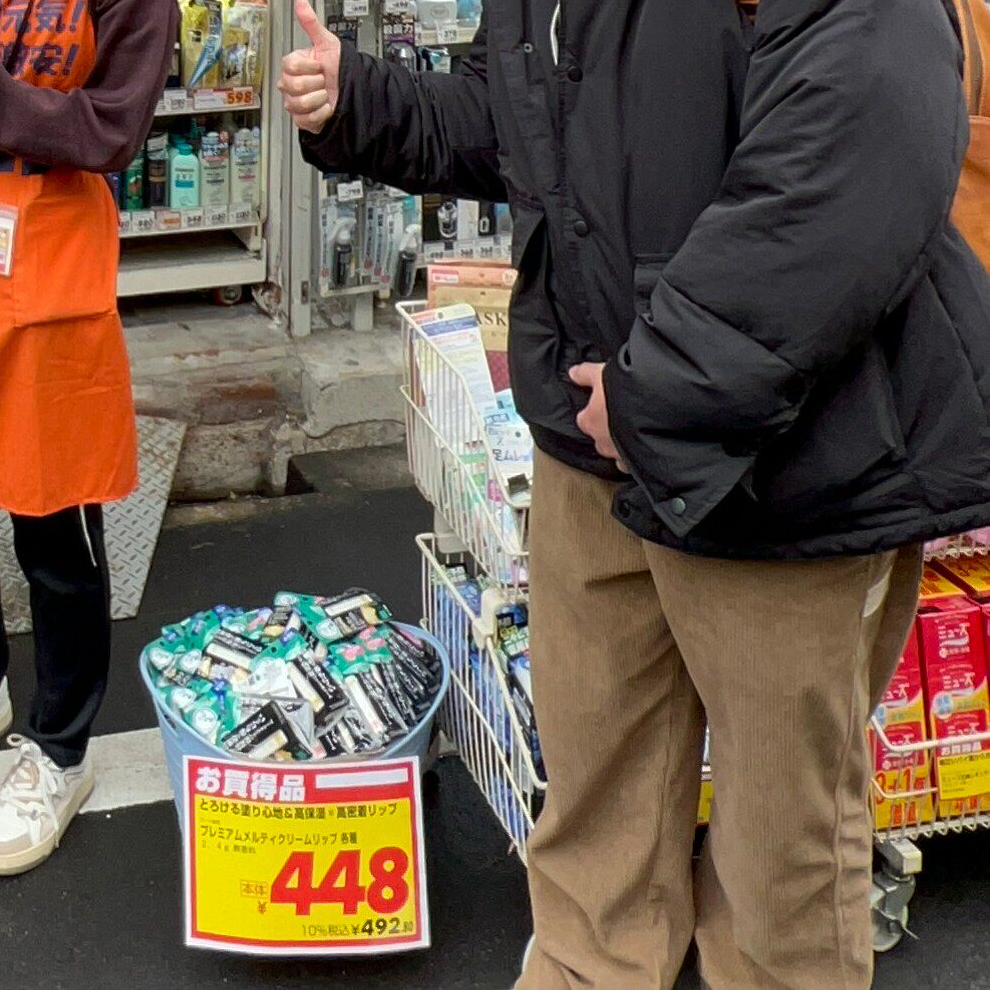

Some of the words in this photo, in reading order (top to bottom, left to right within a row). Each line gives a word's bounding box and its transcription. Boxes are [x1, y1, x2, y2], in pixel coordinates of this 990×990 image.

[226, 91, 253, 105] 598
[195, 765, 306, 802] お買得品
[241, 882, 268, 897] 本体
[269, 846, 410, 916] 448
